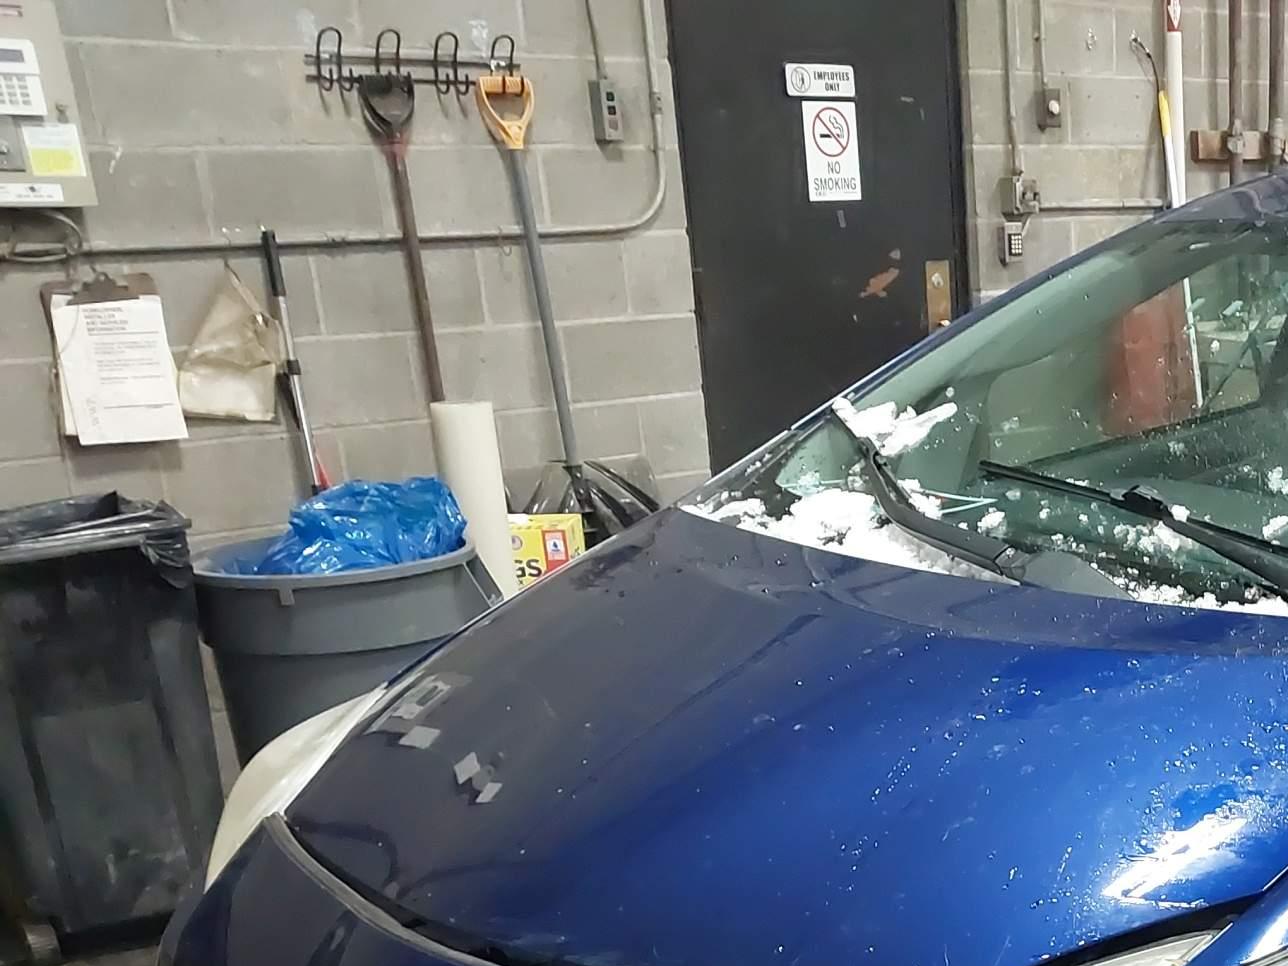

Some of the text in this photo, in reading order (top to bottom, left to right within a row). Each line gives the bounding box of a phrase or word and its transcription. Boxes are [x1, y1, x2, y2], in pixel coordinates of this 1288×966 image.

[813, 71, 850, 81] EMPLOYEES
[824, 82, 840, 92] ONLY
[827, 160, 841, 174] NO
[813, 177, 857, 191] SMOKING
